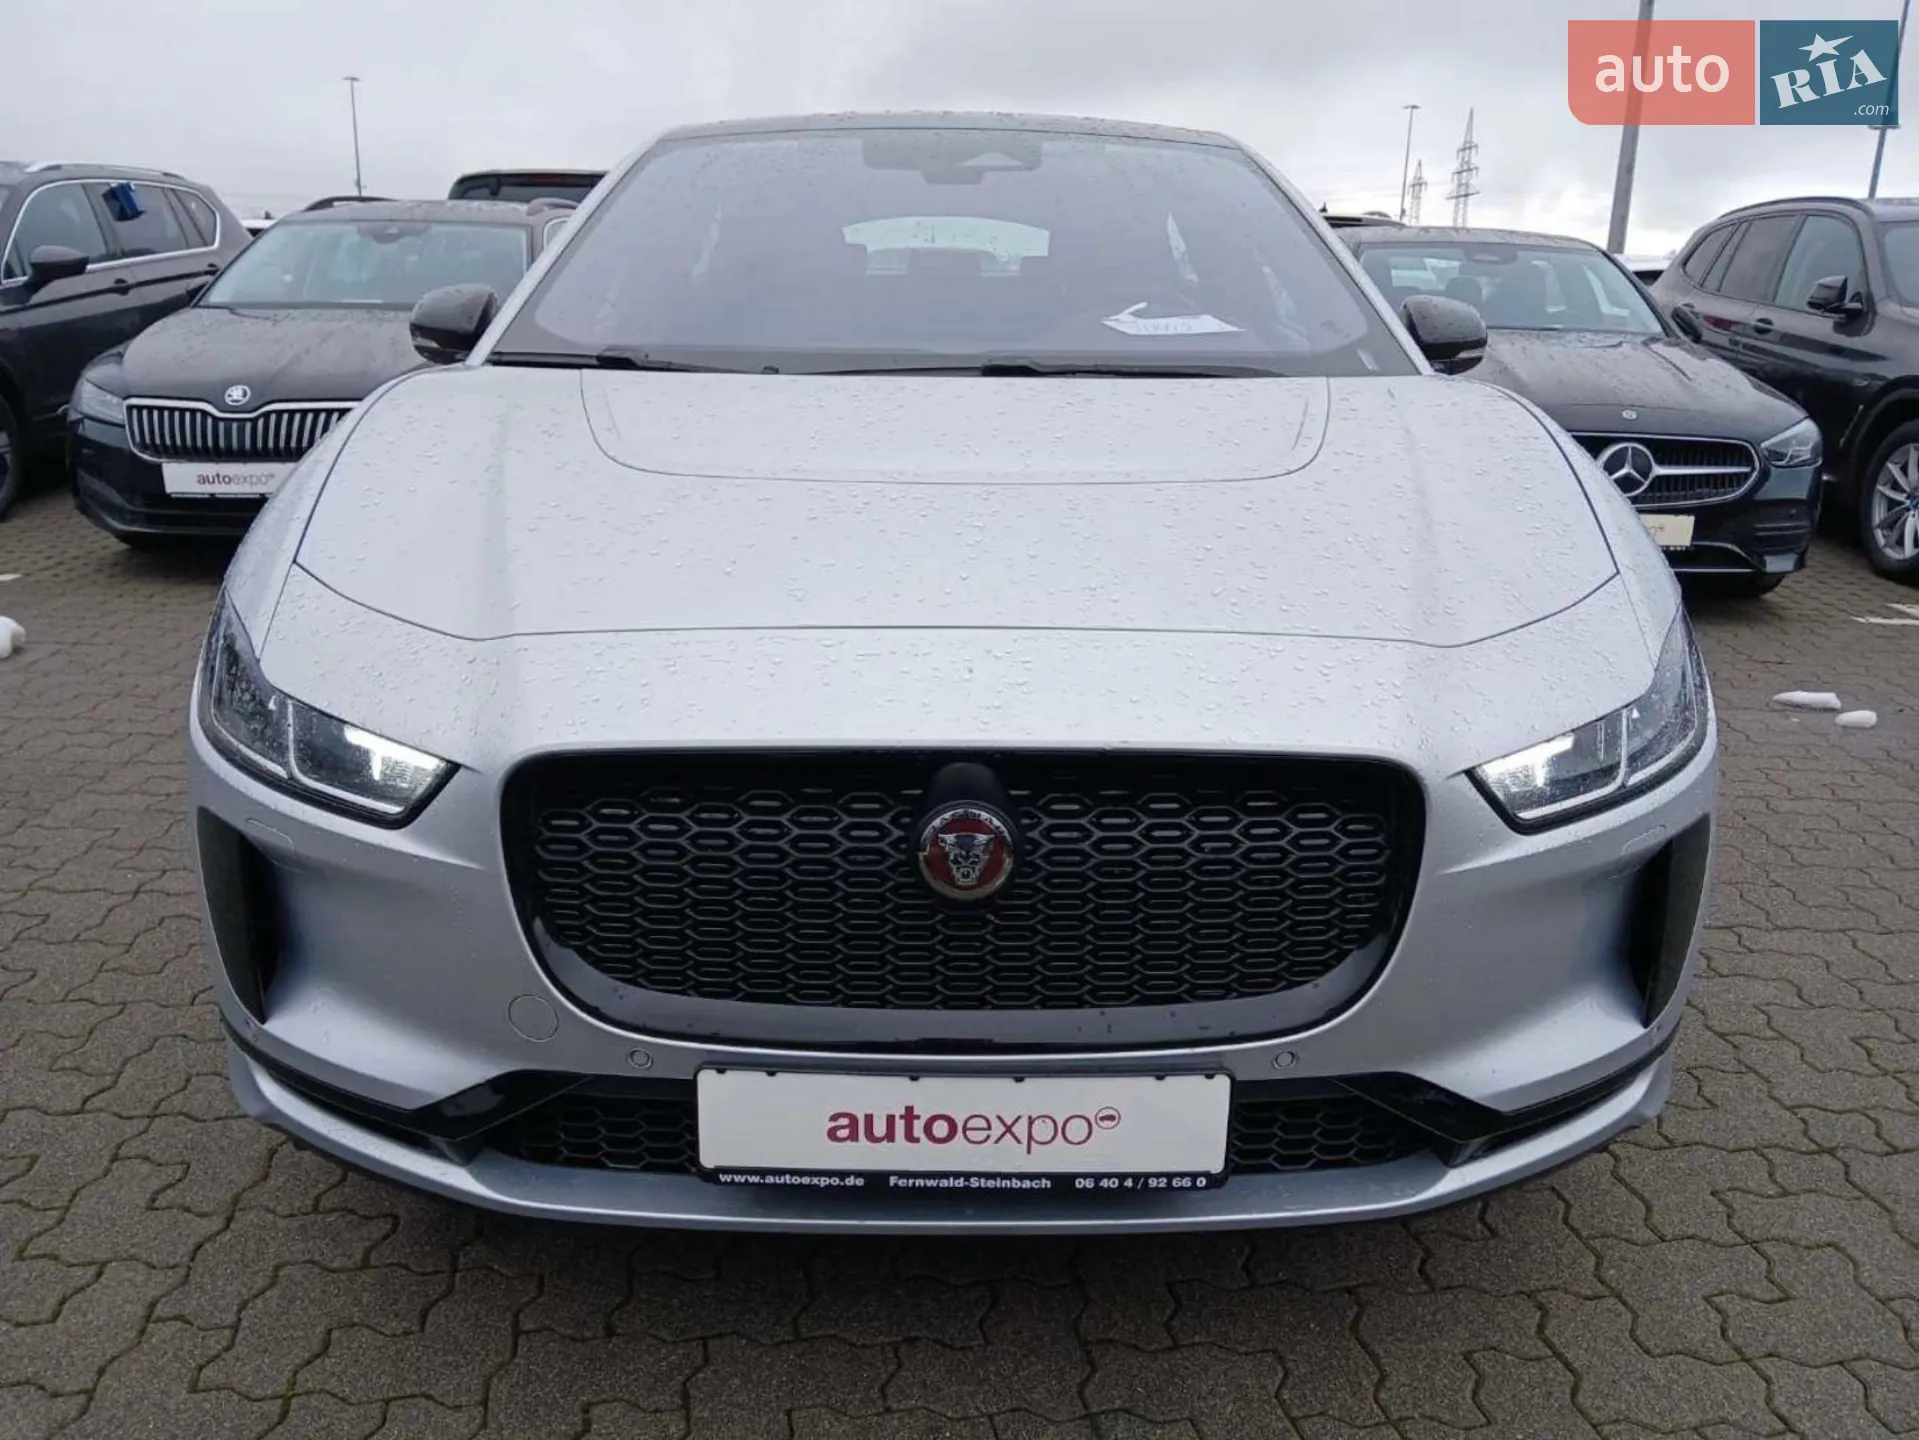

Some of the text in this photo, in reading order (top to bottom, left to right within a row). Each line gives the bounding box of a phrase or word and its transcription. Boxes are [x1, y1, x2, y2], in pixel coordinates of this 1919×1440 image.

[196, 472, 268, 488] autoexpo
[826, 1105, 1094, 1155] autoexpo
[718, 1172, 865, 1188] www.autoexpo.de
[889, 1175, 1052, 1190] Fernwald-Steinbach
[1075, 1177, 1094, 1189] 06
[1100, 1177, 1119, 1189] 40
[1148, 1176, 1168, 1189] 92
[1172, 1177, 1192, 1189] 66
